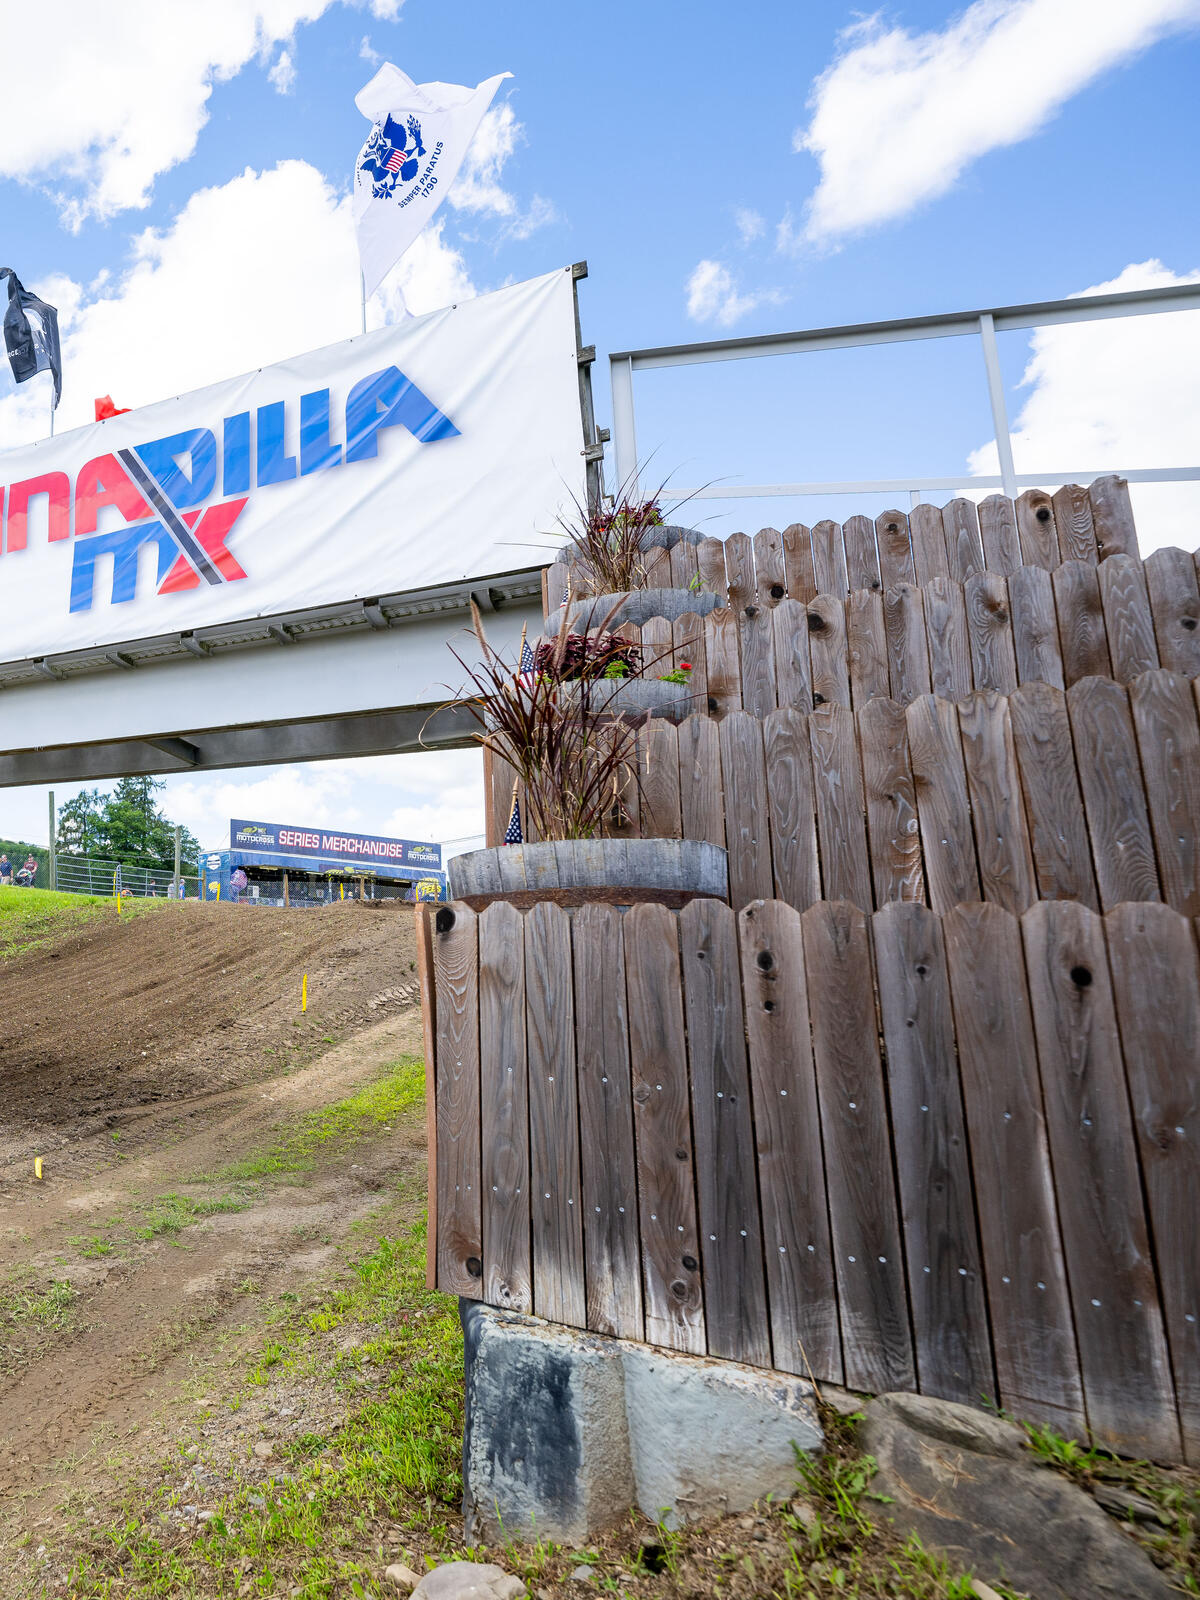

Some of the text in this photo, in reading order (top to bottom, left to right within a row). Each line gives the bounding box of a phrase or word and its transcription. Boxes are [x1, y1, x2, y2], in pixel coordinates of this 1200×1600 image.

[398, 141, 444, 208] SEMPER PARATUS
[421, 176, 438, 198] 1790
[278, 830, 403, 858] SERIES MERCHANDISE
